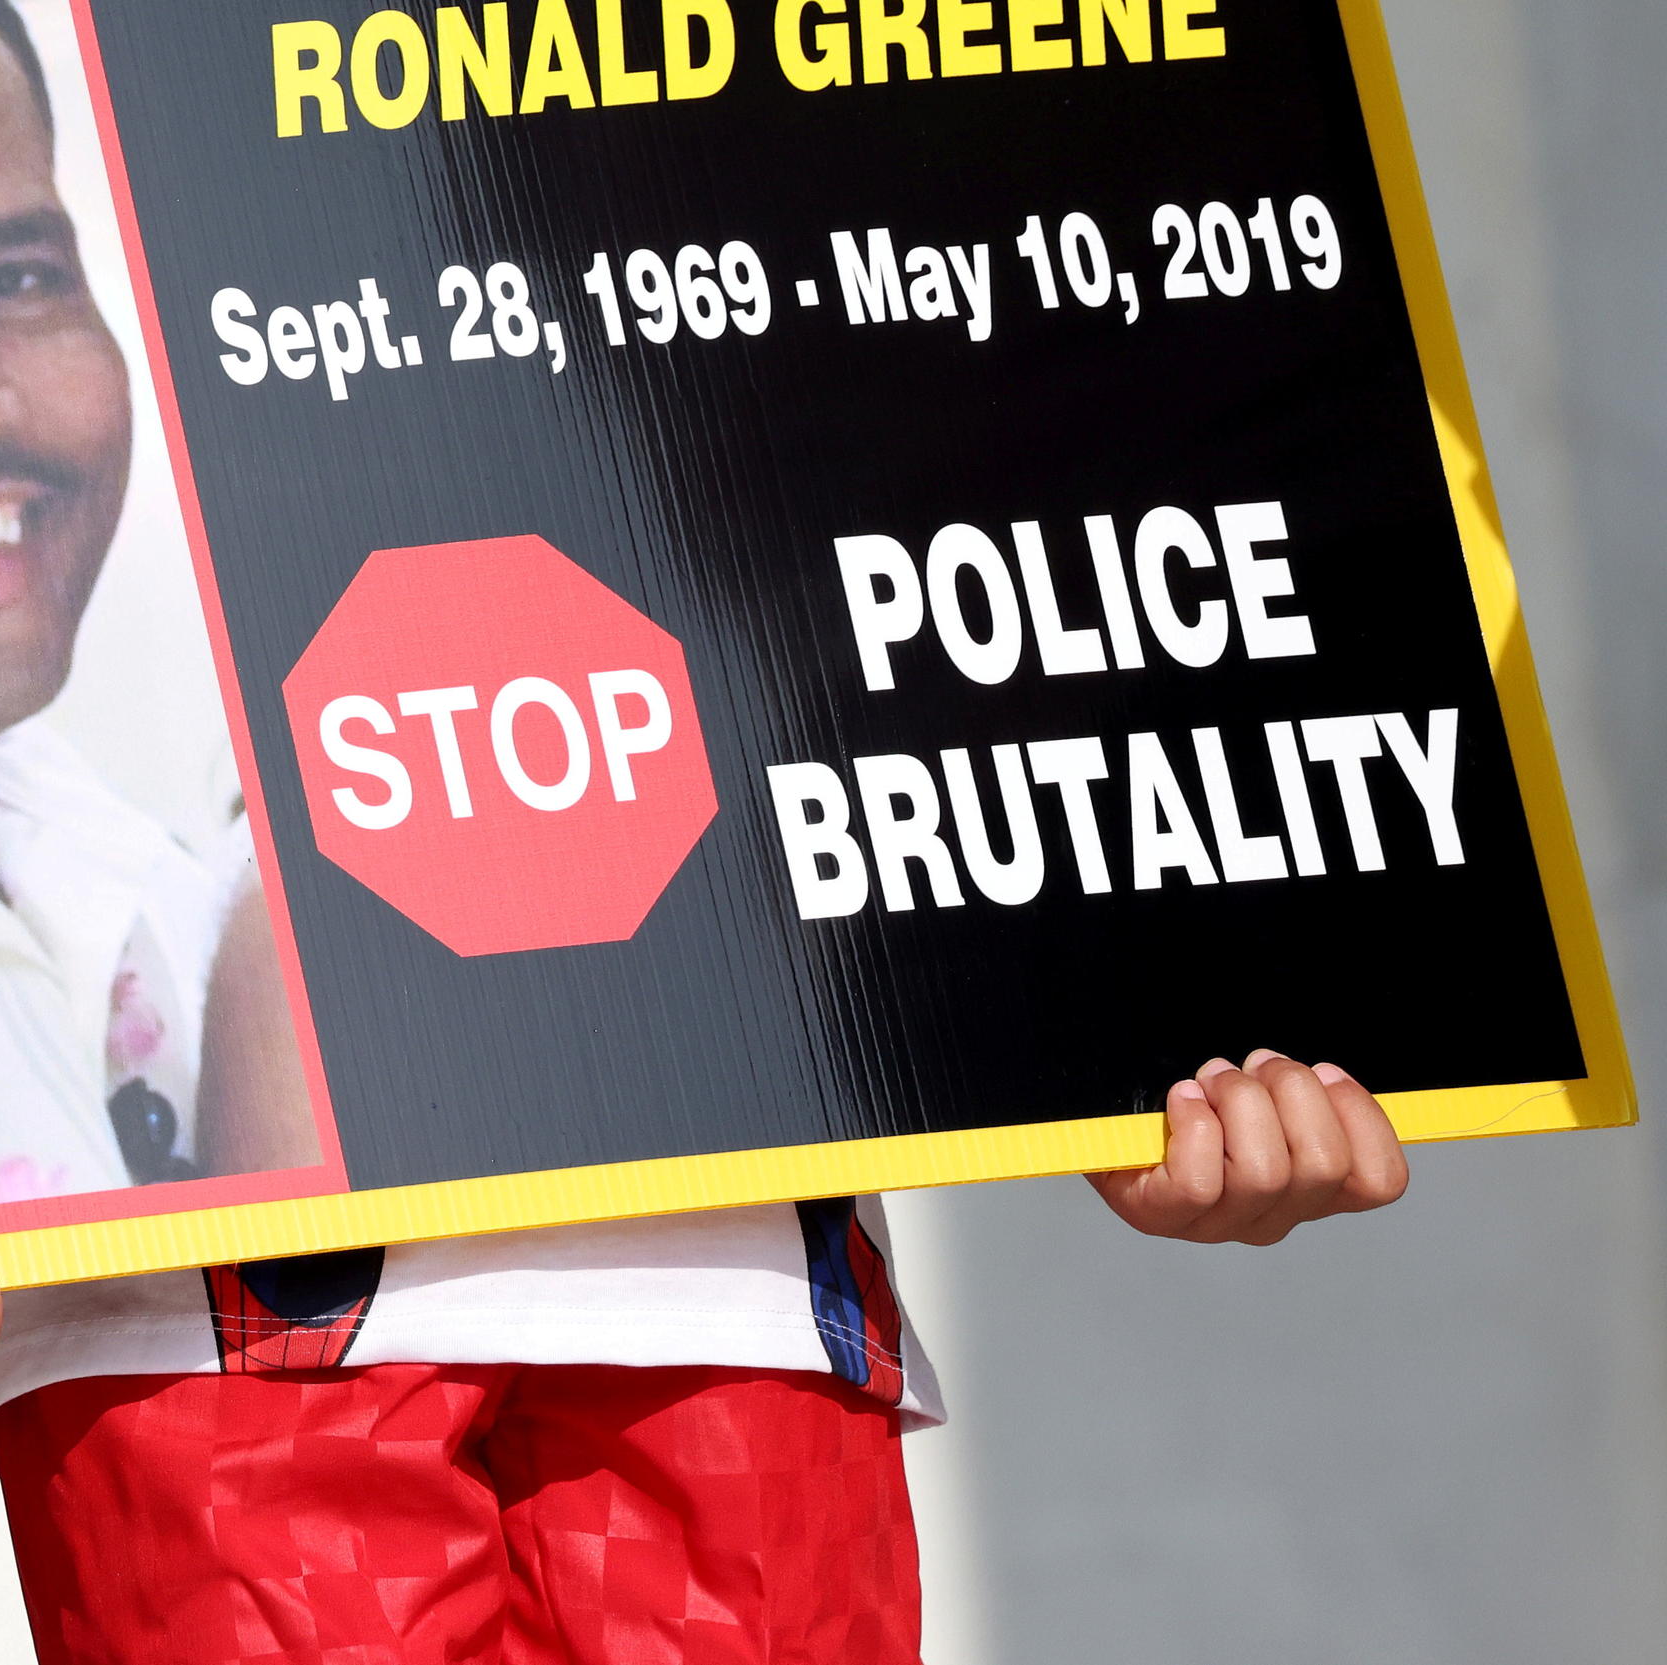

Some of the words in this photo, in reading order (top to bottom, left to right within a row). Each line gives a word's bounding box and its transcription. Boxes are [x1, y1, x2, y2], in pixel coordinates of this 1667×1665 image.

[209, 286, 421, 401] Sept.
[449, 264, 566, 373] 28,
[584, 241, 771, 345] 1969
[830, 227, 992, 341] May
[1017, 210, 1140, 323] 10,
[1151, 193, 1342, 299] 2019
[833, 501, 1317, 692] POLICE
[317, 668, 673, 831] STOP
[766, 708, 1467, 921] BRUTALITY
